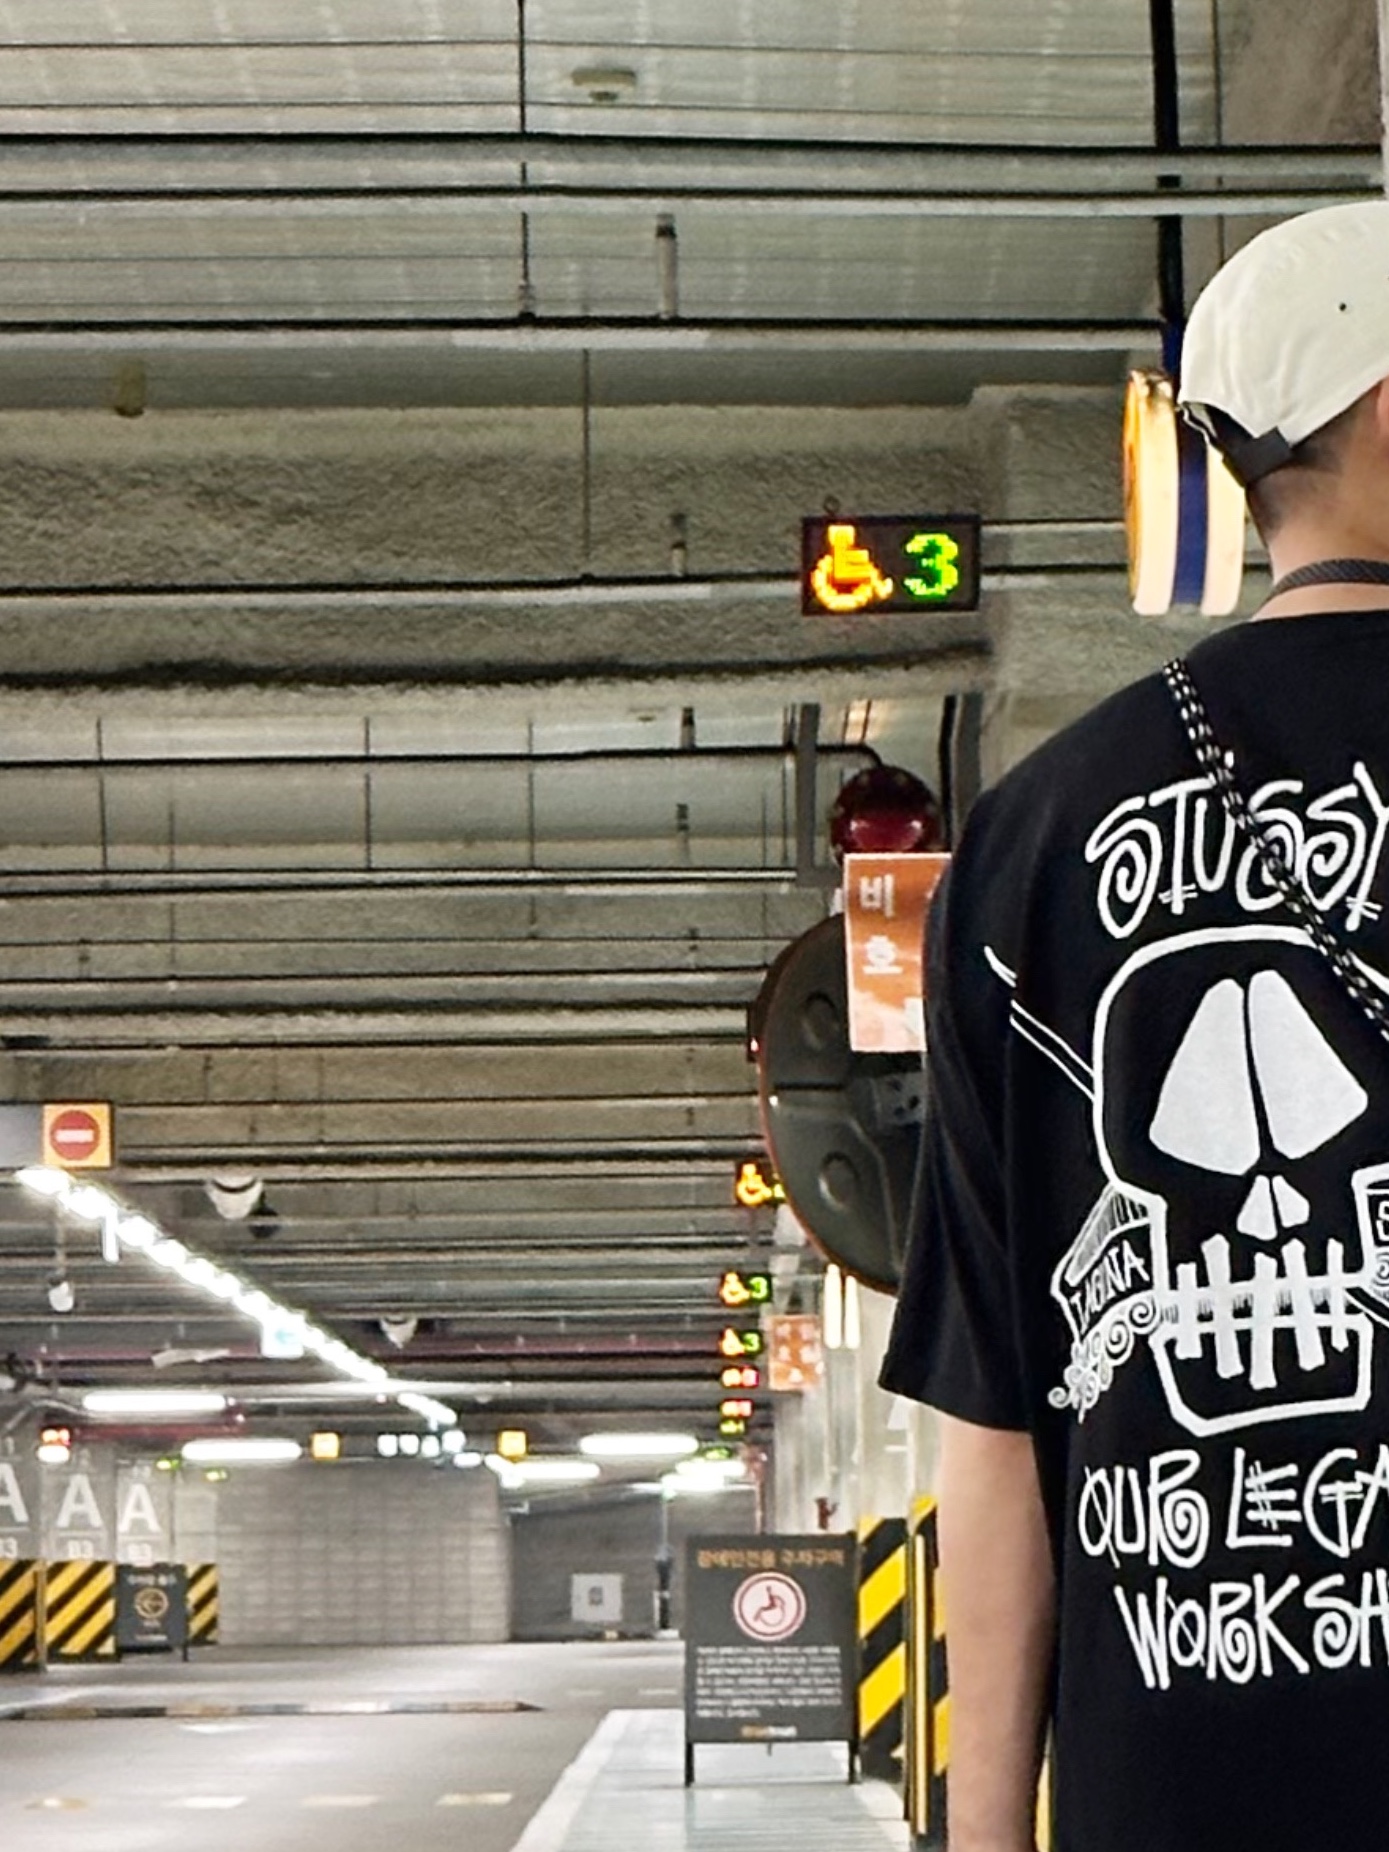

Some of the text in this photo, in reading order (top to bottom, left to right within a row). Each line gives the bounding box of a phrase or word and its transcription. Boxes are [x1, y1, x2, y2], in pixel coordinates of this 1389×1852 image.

[904, 533, 958, 595] 3
[56, 1473, 104, 1528] A
[117, 1483, 162, 1533] A
[1078, 1449, 1210, 1569] OUR
